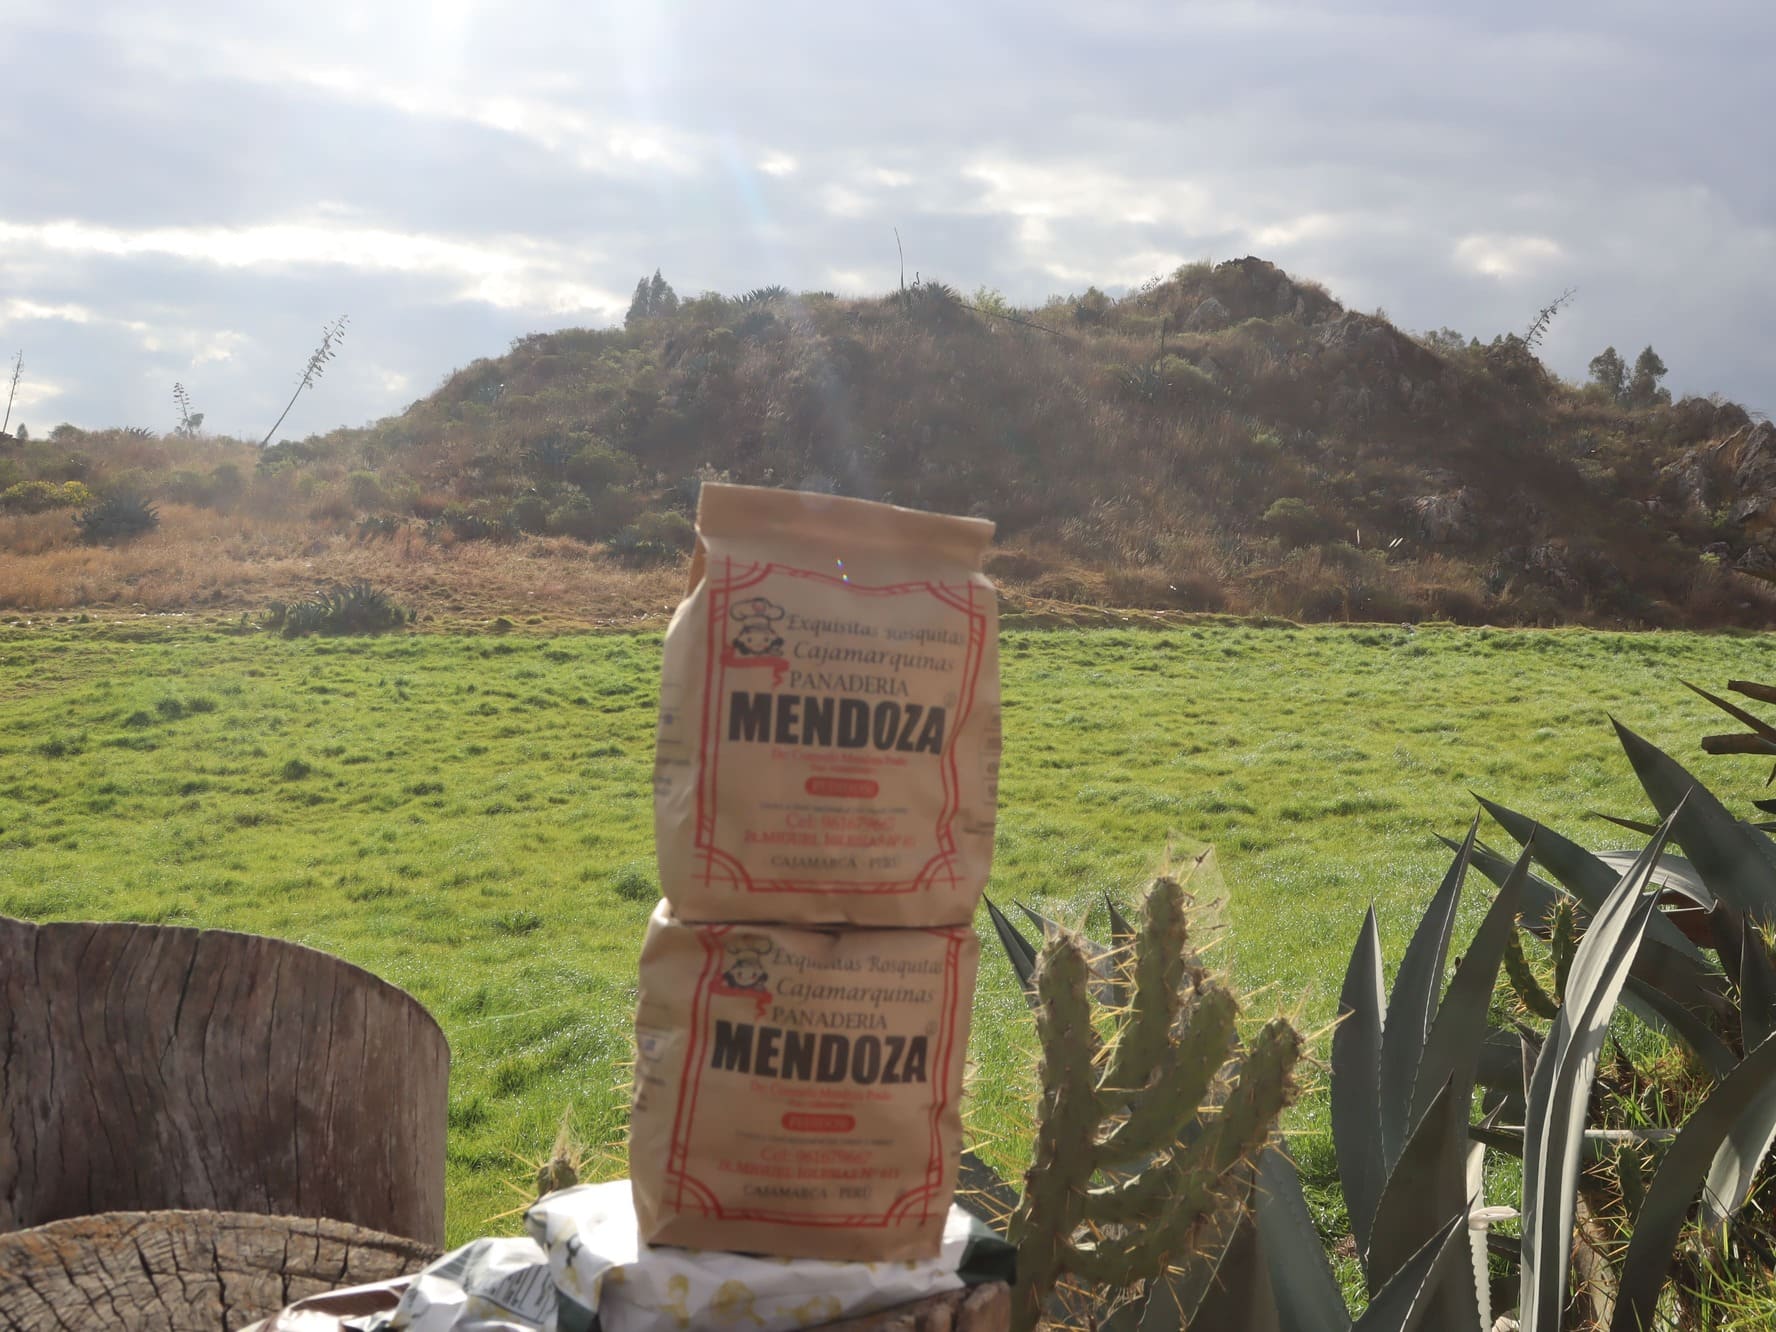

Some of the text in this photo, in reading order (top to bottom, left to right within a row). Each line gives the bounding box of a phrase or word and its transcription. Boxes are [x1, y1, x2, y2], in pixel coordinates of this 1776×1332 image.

[787, 614, 878, 637] Exquisitas
[793, 640, 954, 672] Cajamarquinas
[728, 691, 947, 755] MENDOZA
[776, 975, 934, 1007] Cajamarquinas
[711, 1019, 929, 1084] MENDOZA
